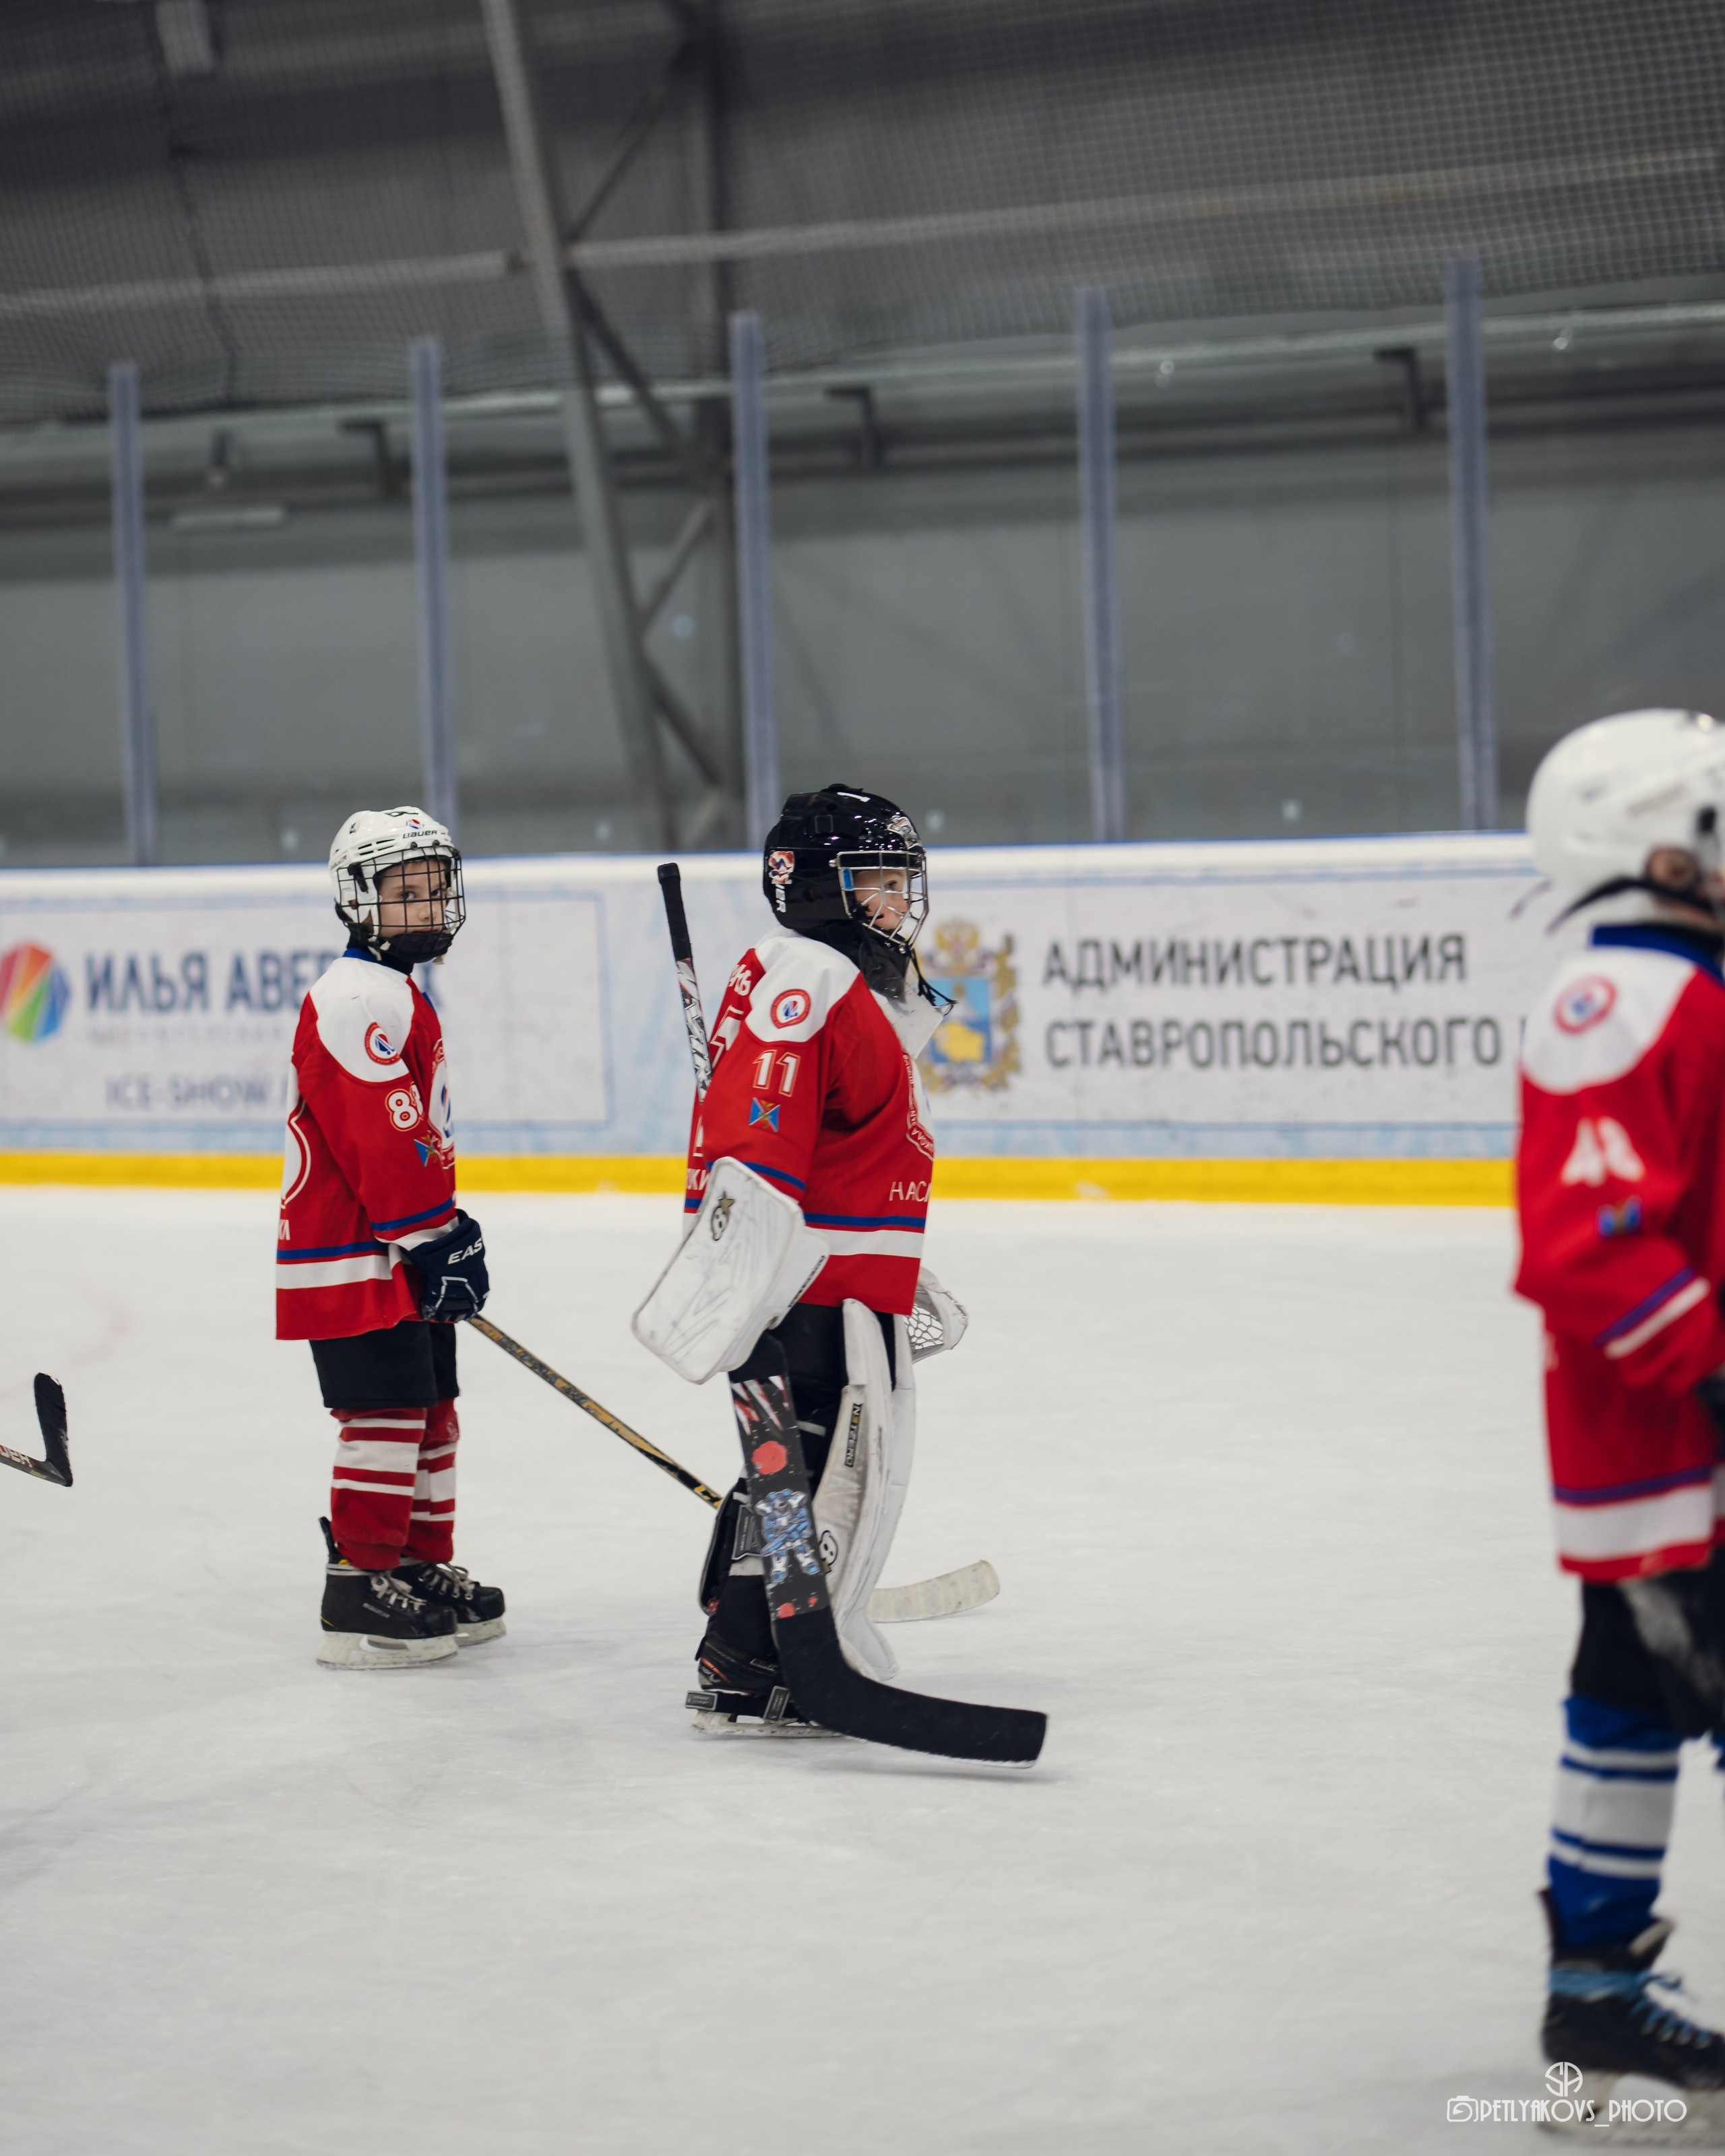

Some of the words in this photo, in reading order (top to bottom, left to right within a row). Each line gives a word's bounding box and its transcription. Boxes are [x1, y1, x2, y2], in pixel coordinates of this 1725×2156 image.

[86, 949, 208, 1013] ИЛЬЯ
[1043, 934, 1467, 992] АДМИНИСТРАЦИЯ
[1045, 1015, 1502, 1069] СТАВРОПОЛЬСКОГО
[752, 1049, 801, 1098] 11
